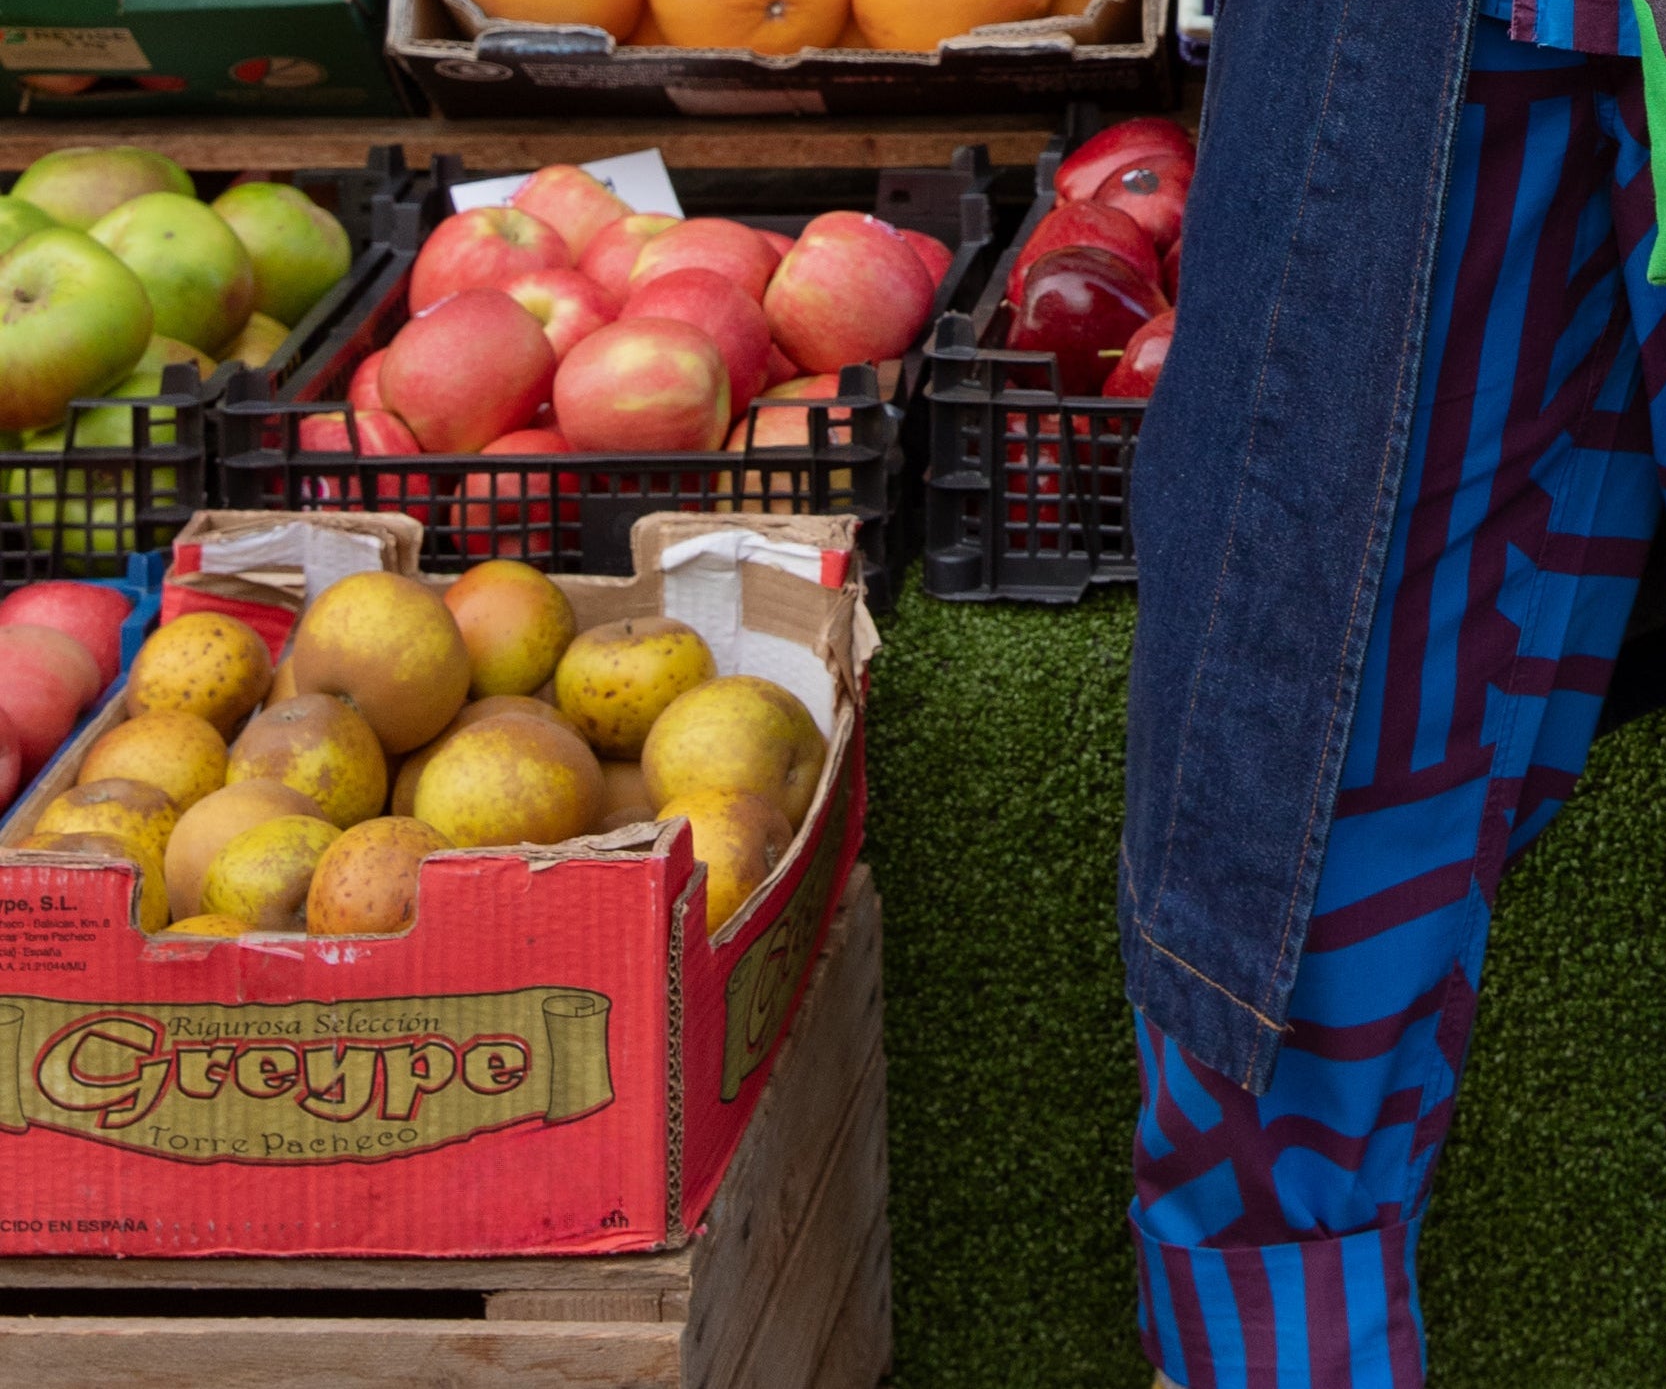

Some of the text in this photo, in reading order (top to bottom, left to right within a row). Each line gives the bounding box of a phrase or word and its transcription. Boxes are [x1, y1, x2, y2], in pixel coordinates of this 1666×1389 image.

[40, 895, 78, 912] S.L.
[51, 932, 96, 942] Pacheco
[23, 946, 62, 958] España
[168, 1011, 441, 1042] Rigurosa Selección
[33, 1009, 532, 1128] Greype
[149, 1125, 419, 1156] Torre Pacheco
[48, 1220, 73, 1233] EN
[77, 1217, 149, 1233] ESPAÑA
